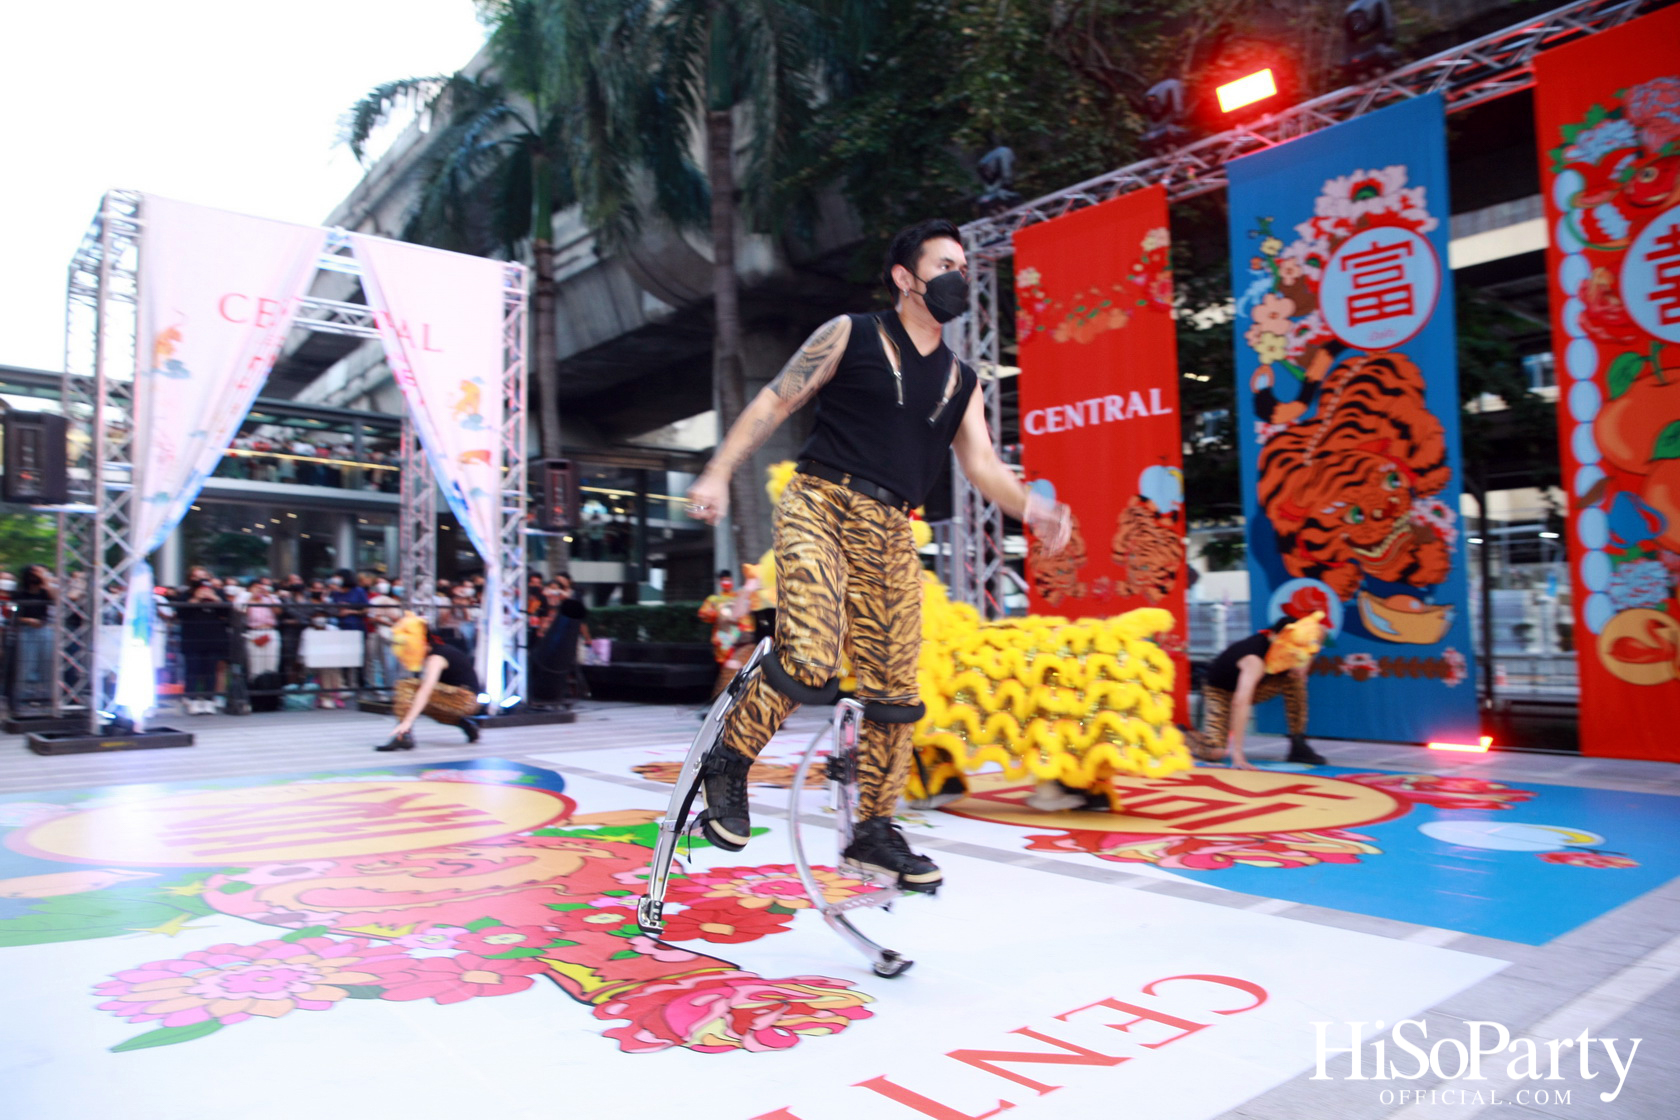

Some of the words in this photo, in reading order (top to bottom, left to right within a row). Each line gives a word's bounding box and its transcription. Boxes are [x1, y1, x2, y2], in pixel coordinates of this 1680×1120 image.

[1341, 240, 1415, 327] 富
[1024, 388, 1173, 436] CENTRAL
[749, 974, 1268, 1120] CENT
